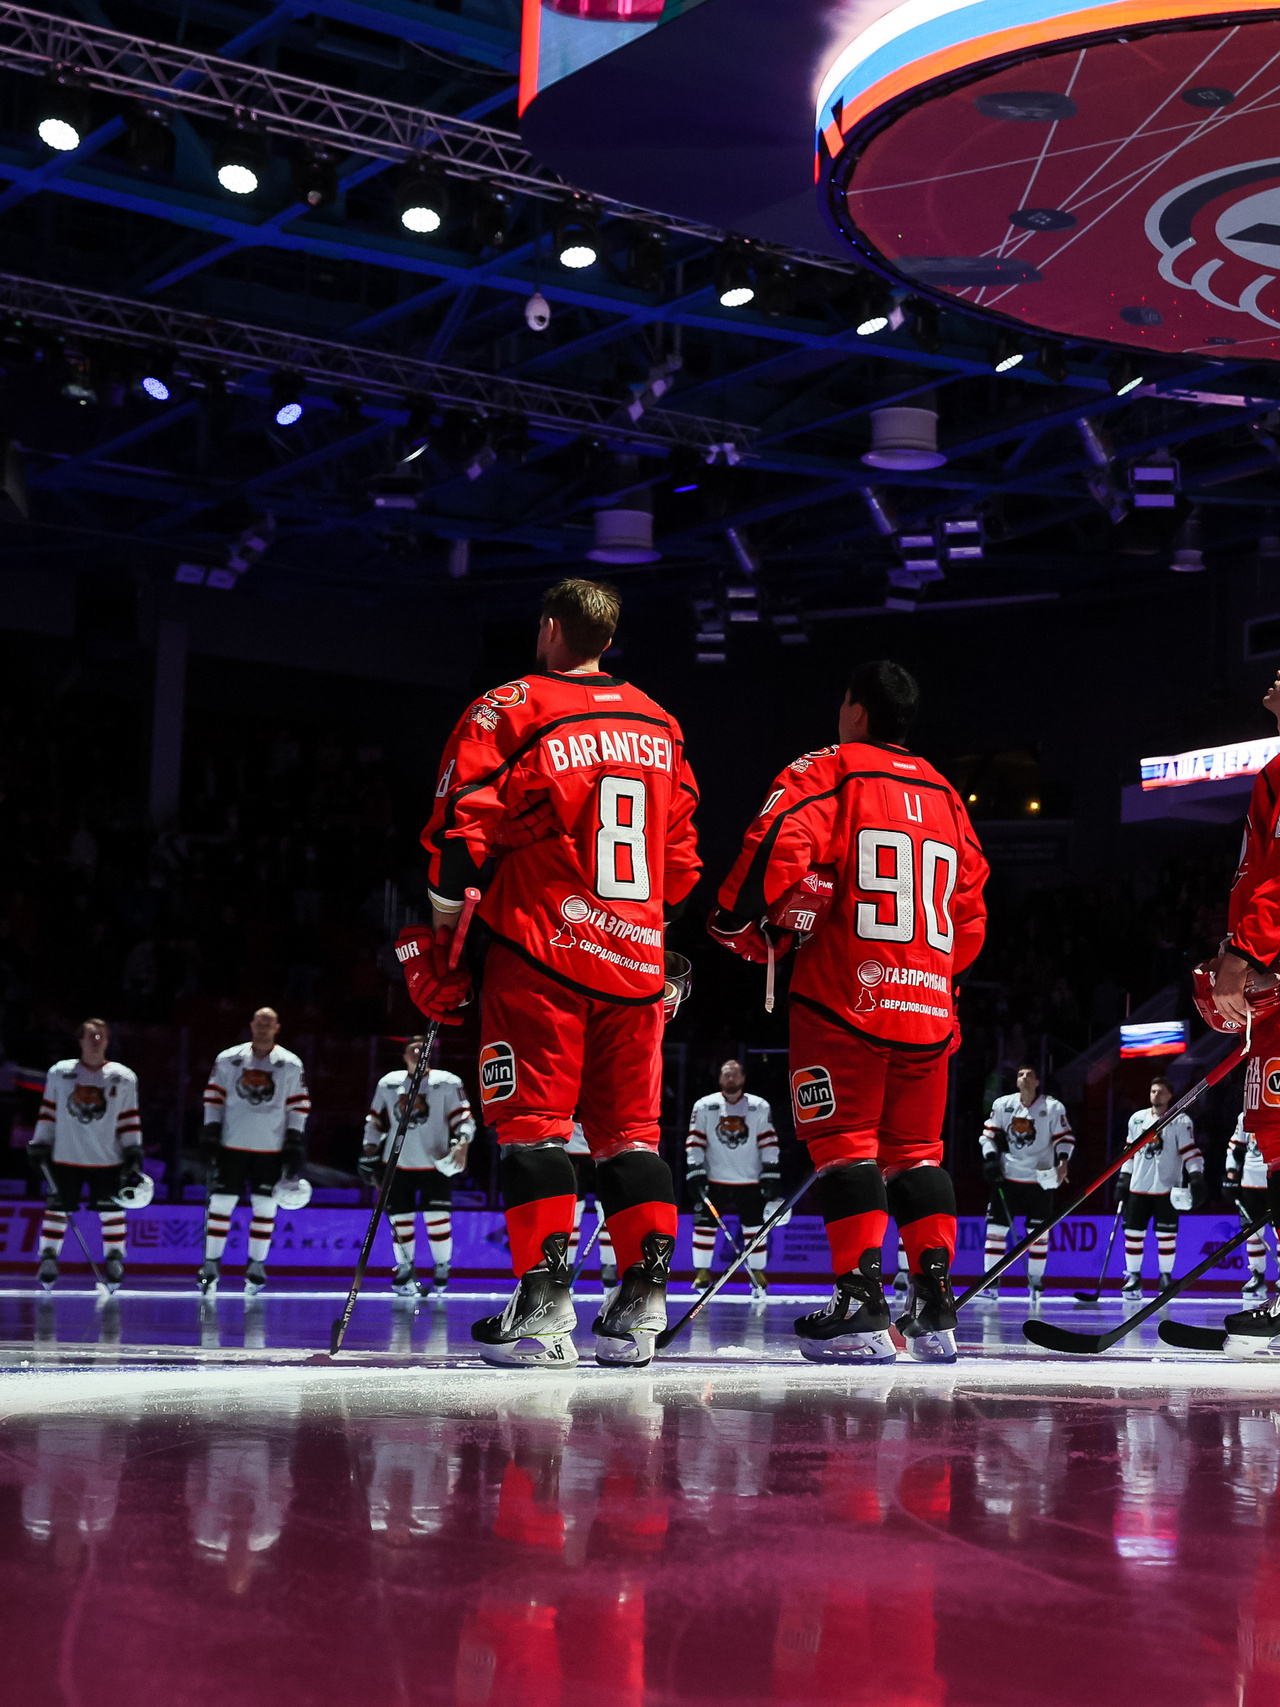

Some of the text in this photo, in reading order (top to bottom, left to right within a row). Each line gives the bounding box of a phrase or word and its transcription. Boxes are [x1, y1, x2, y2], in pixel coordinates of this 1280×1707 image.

[903, 791, 923, 823] LI
[595, 774, 651, 902] 8
[855, 828, 958, 956] 90
[794, 912, 816, 931] 90
[579, 940, 640, 971] СВЕРДЛОВСКАЯ
[879, 998, 932, 1016] СВЕРДЛОВСКАЯ
[483, 1062, 511, 1083] Win
[800, 1085, 830, 1104] Win
